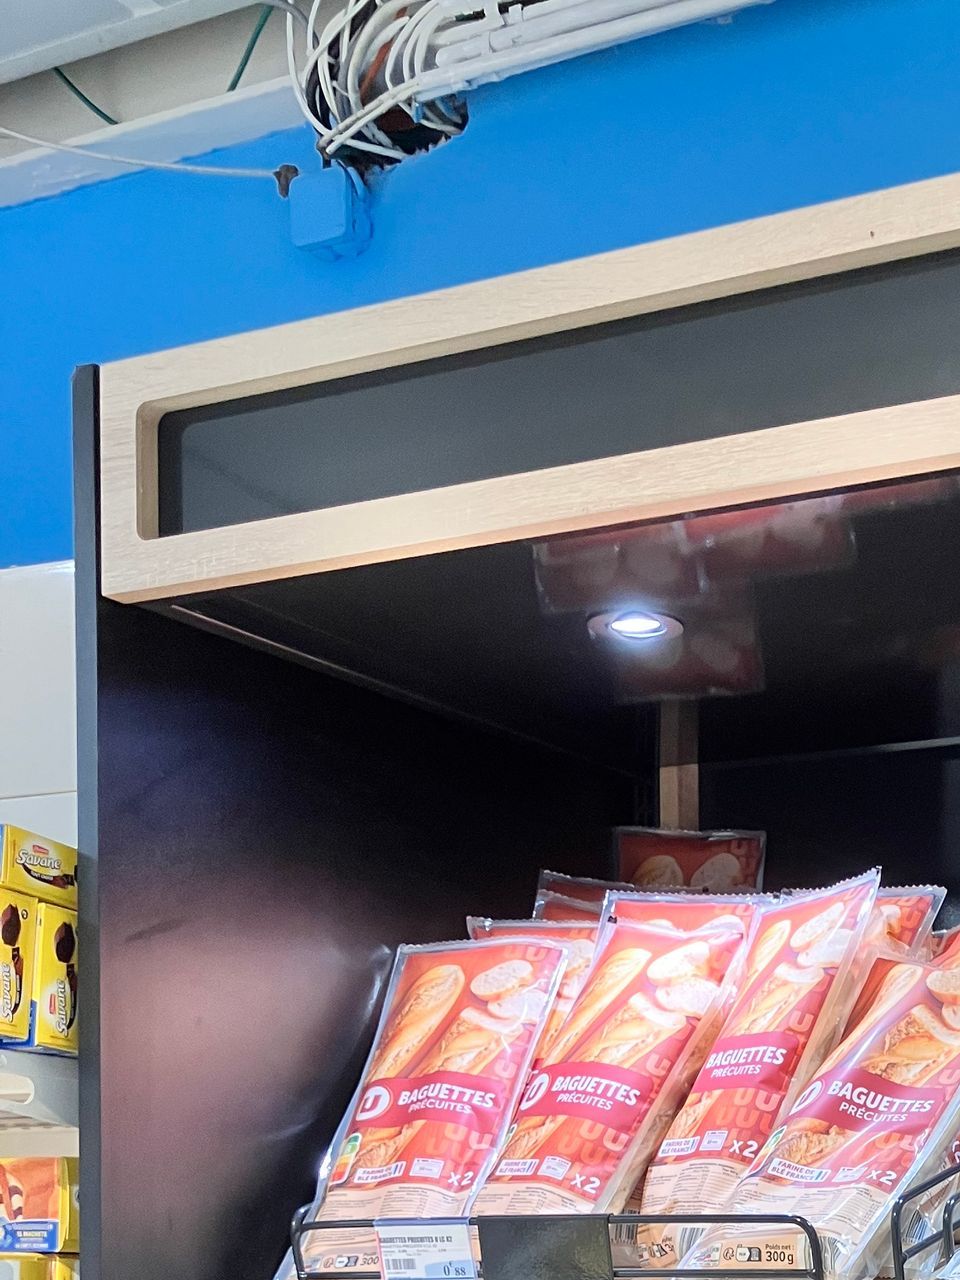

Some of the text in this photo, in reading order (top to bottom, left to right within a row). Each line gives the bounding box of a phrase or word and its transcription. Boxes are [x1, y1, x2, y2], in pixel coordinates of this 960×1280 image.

[16, 848, 62, 869] Savane
[705, 1046, 787, 1069] BAGUETTES
[711, 1065, 762, 1078] PRÉCUITES
[397, 1083, 496, 1108] BAGUETTES
[551, 1075, 641, 1106] BAGUETTES
[827, 1080, 935, 1113] BAGUETTES
[408, 1098, 473, 1114] PRÉCUITES
[556, 1092, 614, 1111] PRÉCUITES
[839, 1103, 909, 1123] PRÉCUITES
[771, 1166, 816, 1181] BLÉ FRANCE
[777, 1161, 816, 1175] FARINE DE
[765, 1251, 786, 1262] 300
